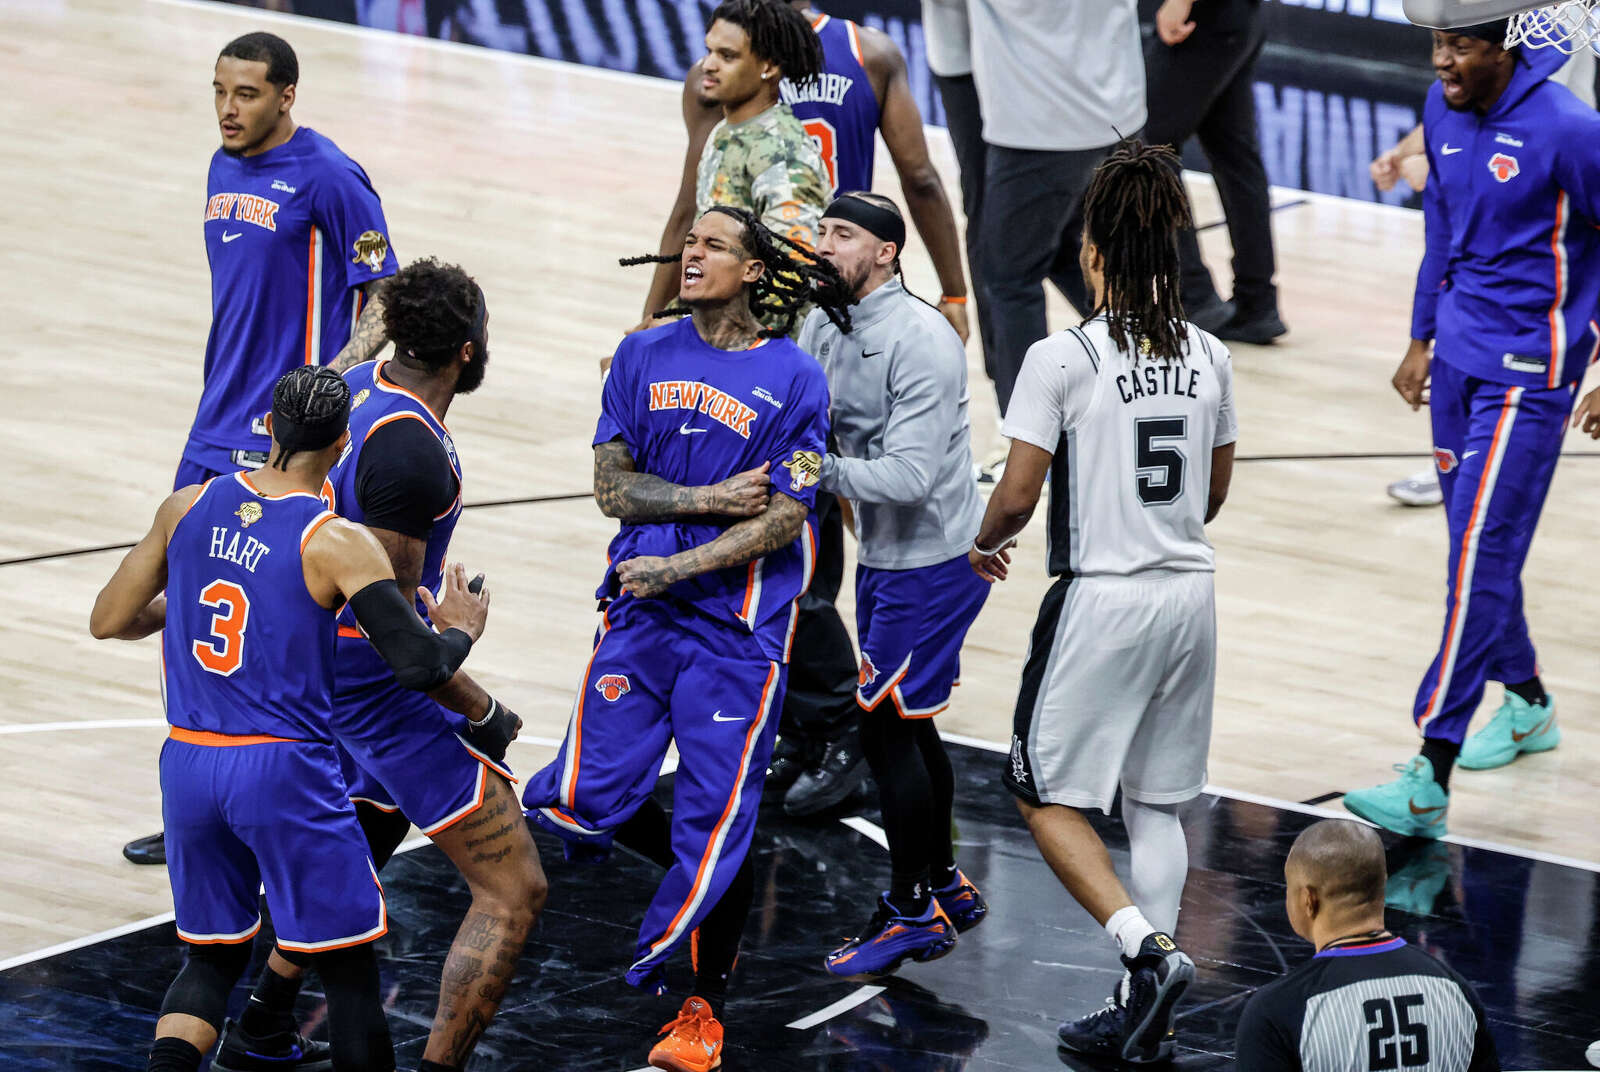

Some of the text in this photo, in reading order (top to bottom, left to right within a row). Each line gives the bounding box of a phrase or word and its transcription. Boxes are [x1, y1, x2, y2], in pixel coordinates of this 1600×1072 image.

[204, 192, 280, 232] NEW YORK
[1115, 365, 1201, 404] CASTLE
[1134, 415, 1188, 508] 5
[208, 526, 271, 574] HART
[192, 578, 251, 678] 3
[1362, 993, 1430, 1071] 25
